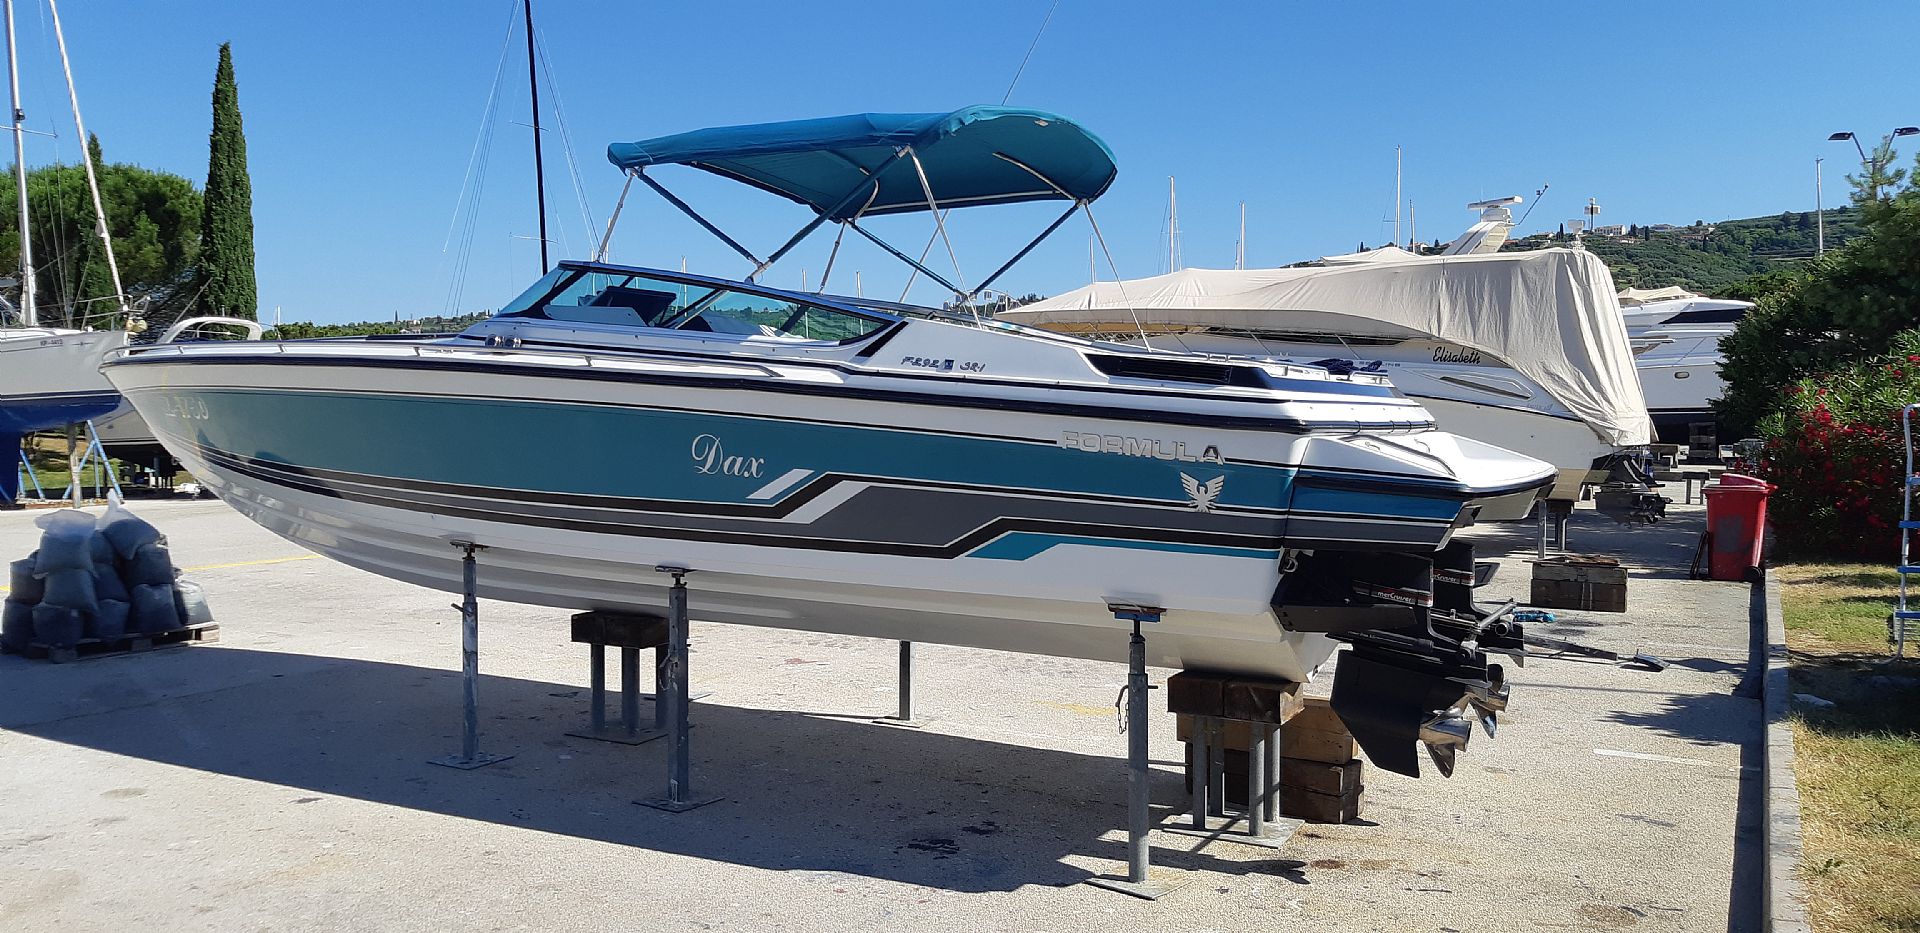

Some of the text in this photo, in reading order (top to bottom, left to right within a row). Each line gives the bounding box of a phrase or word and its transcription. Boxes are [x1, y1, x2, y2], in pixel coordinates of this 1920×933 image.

[1432, 346, 1481, 364] Elisabeth
[691, 433, 765, 479] Dax
[1062, 430, 1225, 465] FORMULA
